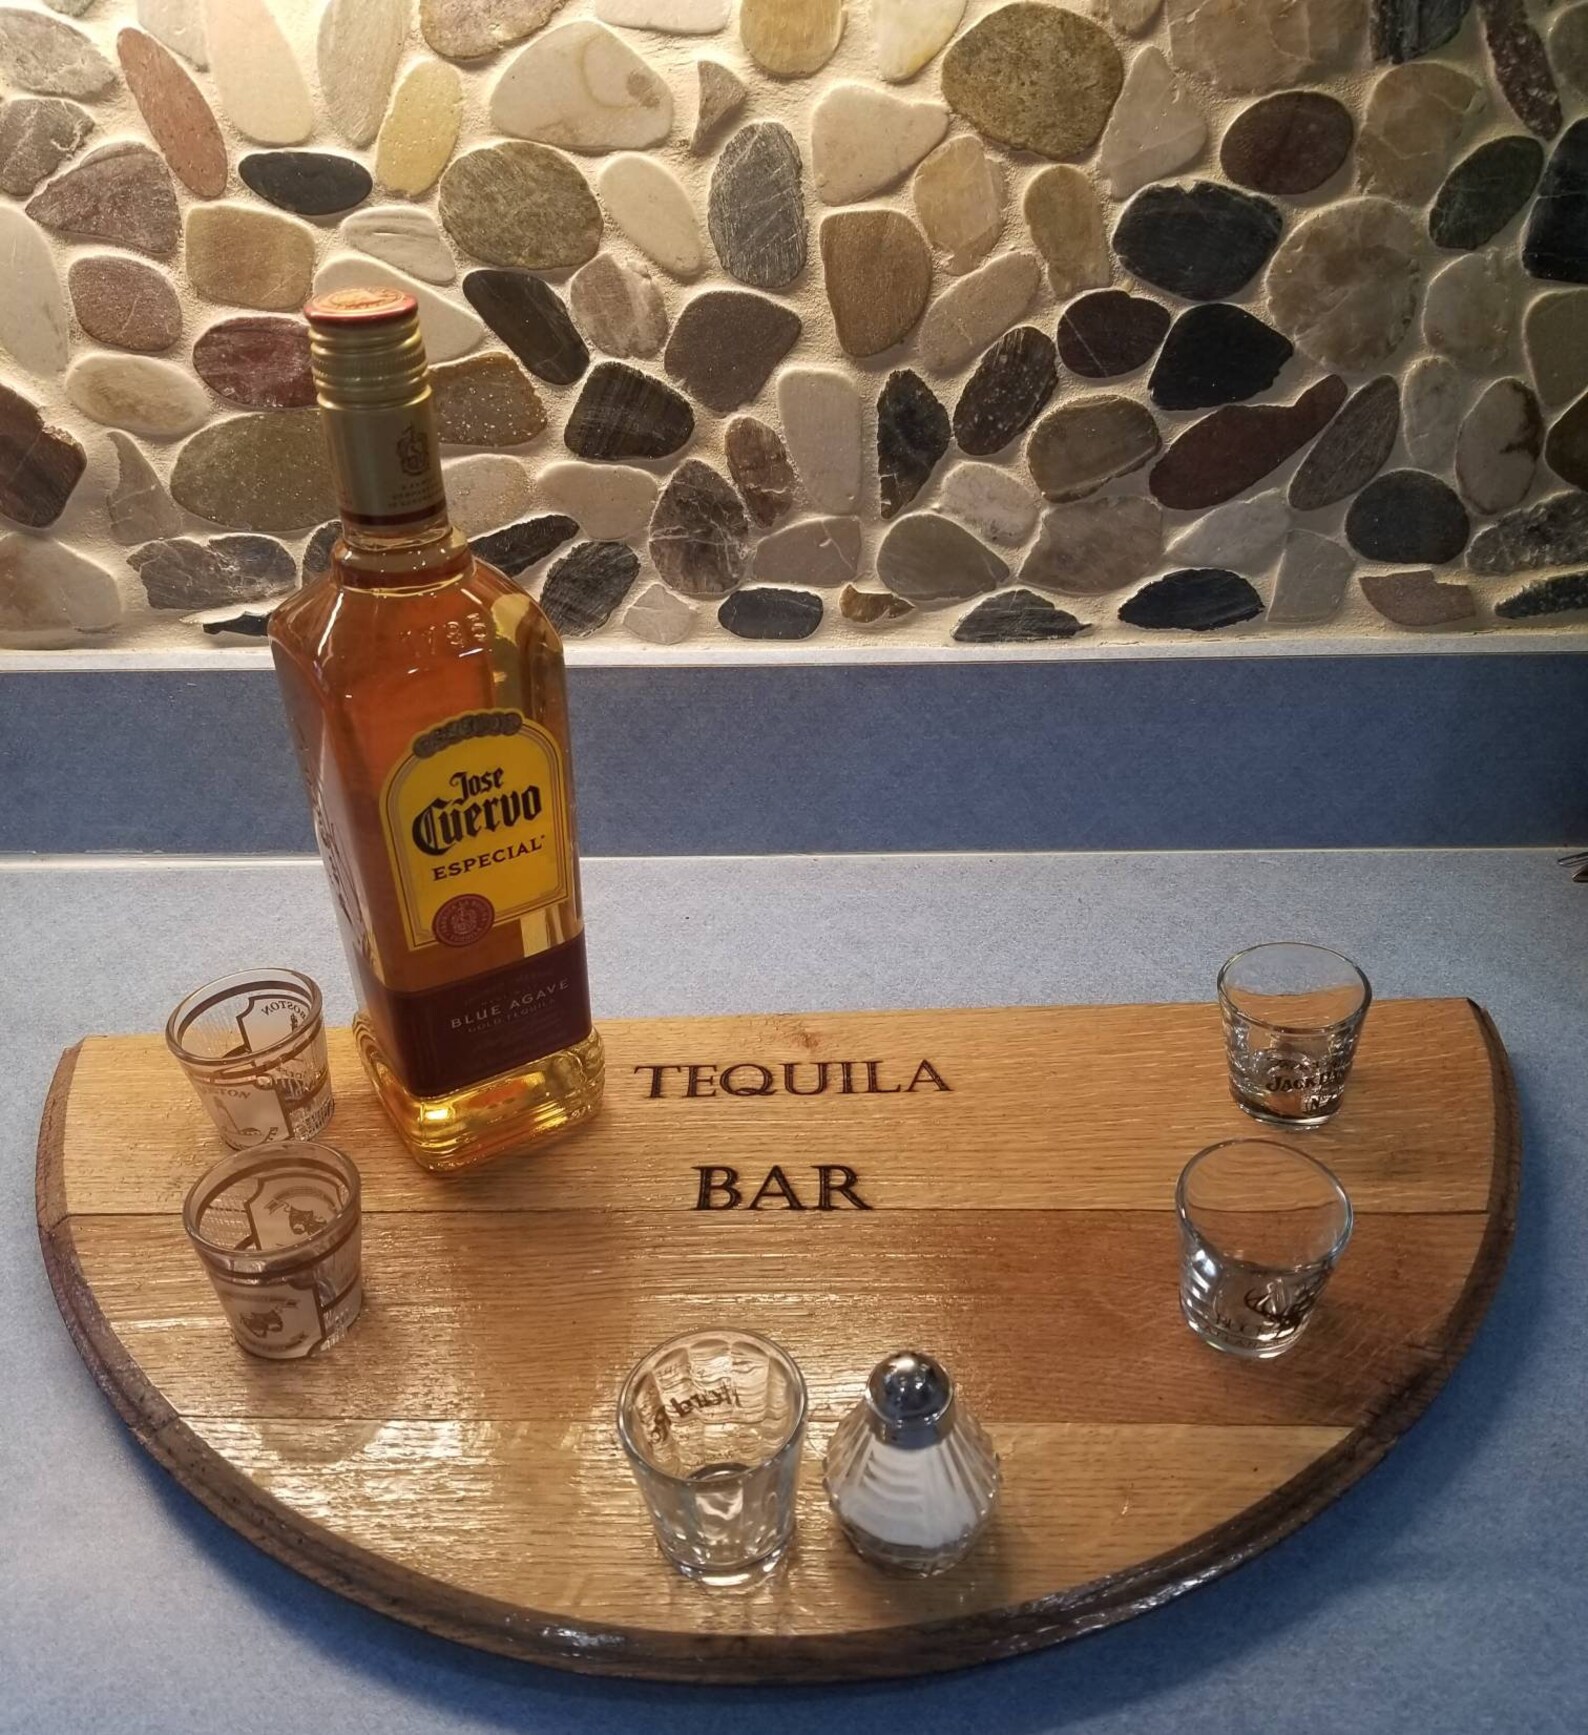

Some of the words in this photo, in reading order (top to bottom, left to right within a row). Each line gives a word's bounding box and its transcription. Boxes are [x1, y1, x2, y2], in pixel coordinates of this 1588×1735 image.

[449, 766, 505, 805] Jose
[412, 785, 542, 856] Cuervo
[432, 836, 544, 882] ESPECIAL
[450, 1004, 502, 1030] BLUE
[509, 976, 570, 1010] AGAVE
[634, 1059, 954, 1099] TEQUILA
[690, 1164, 874, 1211] BAR
